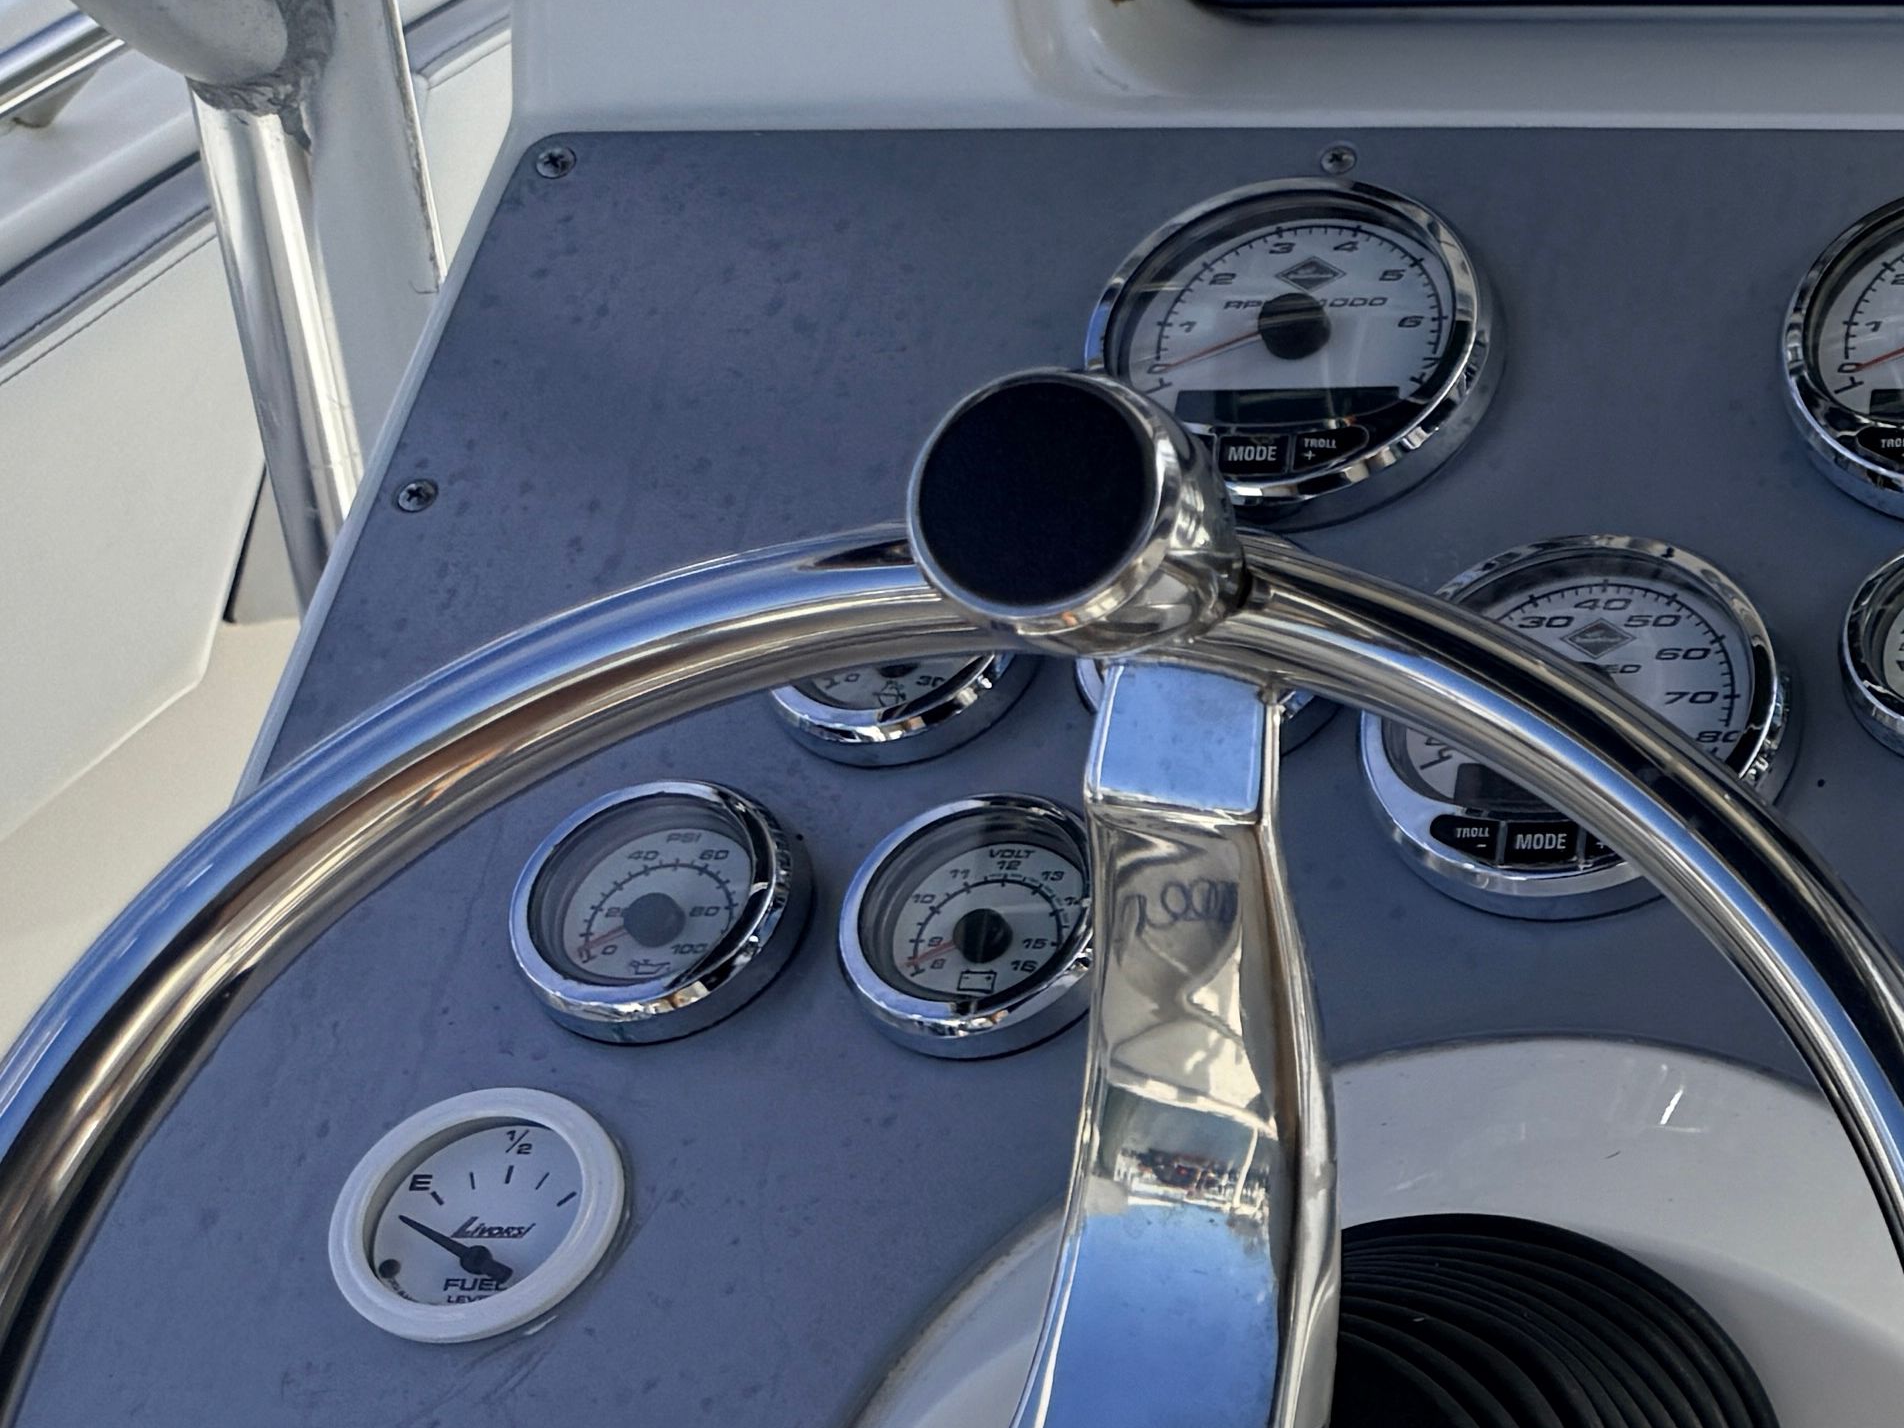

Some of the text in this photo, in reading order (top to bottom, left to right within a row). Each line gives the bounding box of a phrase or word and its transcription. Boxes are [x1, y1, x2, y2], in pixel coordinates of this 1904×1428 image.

[1269, 242, 1296, 254] 3
[1333, 240, 1359, 254] 4
[1209, 272, 1236, 285] 2
[1379, 269, 1406, 281] 5
[1179, 321, 1197, 333] 1
[1397, 316, 1425, 328] 6
[1865, 320, 1882, 332] 1
[1304, 437, 1337, 449] TROLL
[1228, 445, 1277, 462] MODE
[1573, 598, 1632, 610] 40
[1517, 616, 1574, 629] 30
[1624, 614, 1681, 631] 50
[1655, 648, 1712, 661] 60
[1664, 692, 1720, 704] 70
[665, 832, 702, 844] PSI
[1456, 827, 1489, 838] TROLL
[1516, 833, 1566, 850] MODE
[627, 850, 660, 861] 40
[699, 849, 730, 860] 60
[989, 848, 1036, 859] VOLT
[996, 860, 1022, 870] 12
[949, 869, 971, 879] 11
[1041, 871, 1065, 881] 13
[913, 894, 937, 904] 10
[689, 906, 720, 917] 80
[928, 936, 943, 947] 9
[1023, 938, 1047, 949] 15
[601, 945, 618, 955] 0
[1010, 960, 1039, 972] 16
[506, 1129, 533, 1155] 1/2
[409, 1174, 433, 1191] E
[444, 1278, 508, 1291] FUEL
